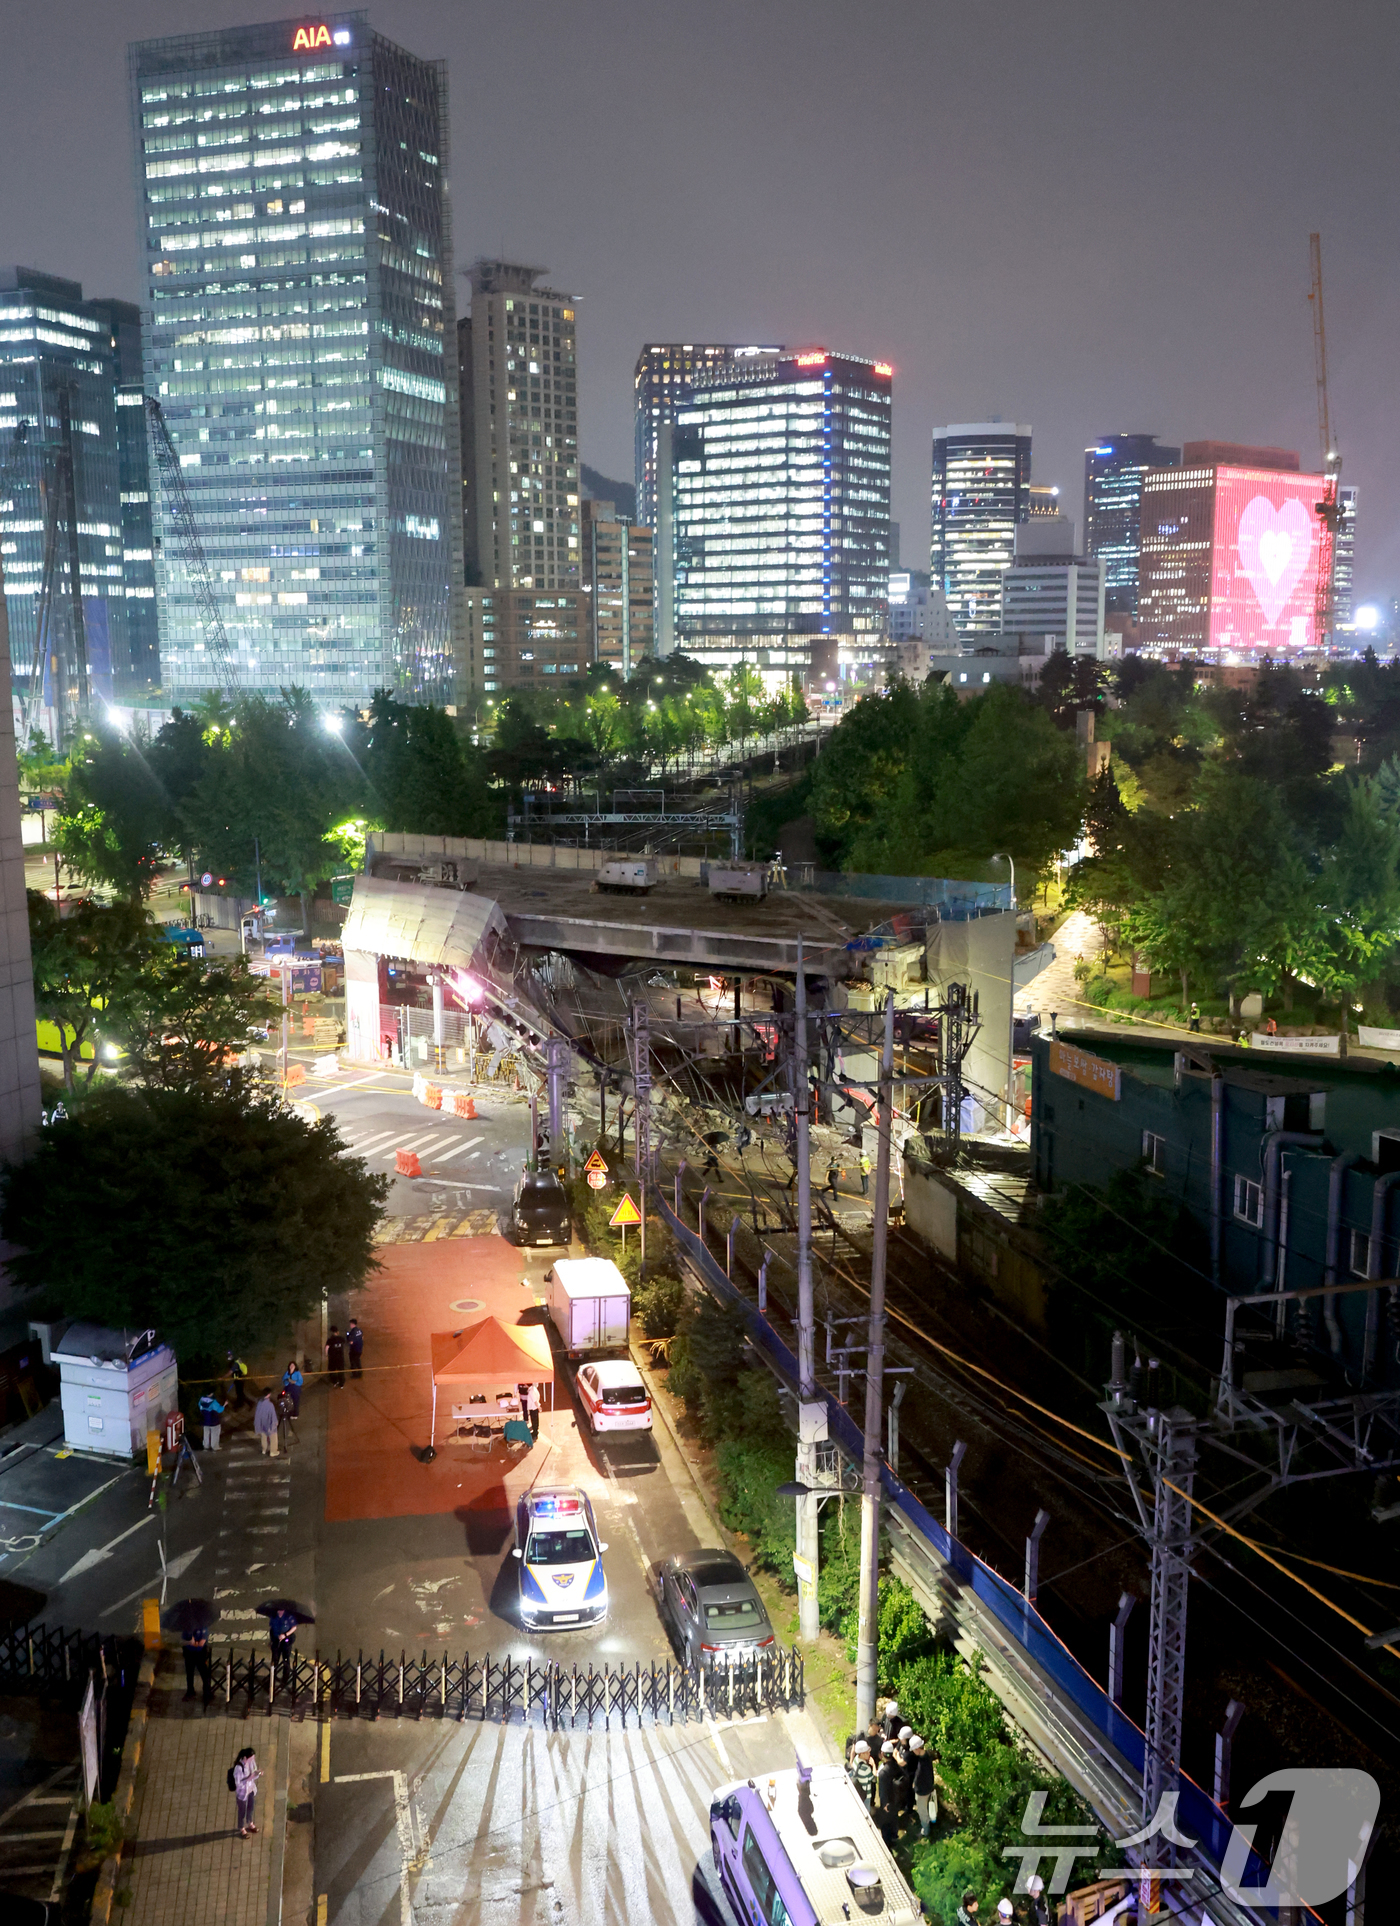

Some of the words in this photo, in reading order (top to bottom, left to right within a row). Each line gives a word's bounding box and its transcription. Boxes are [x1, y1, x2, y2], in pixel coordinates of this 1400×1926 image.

[293, 24, 332, 50] AIA
[797, 353, 826, 366] meritz
[1091, 1063, 1115, 1088] 감자탕
